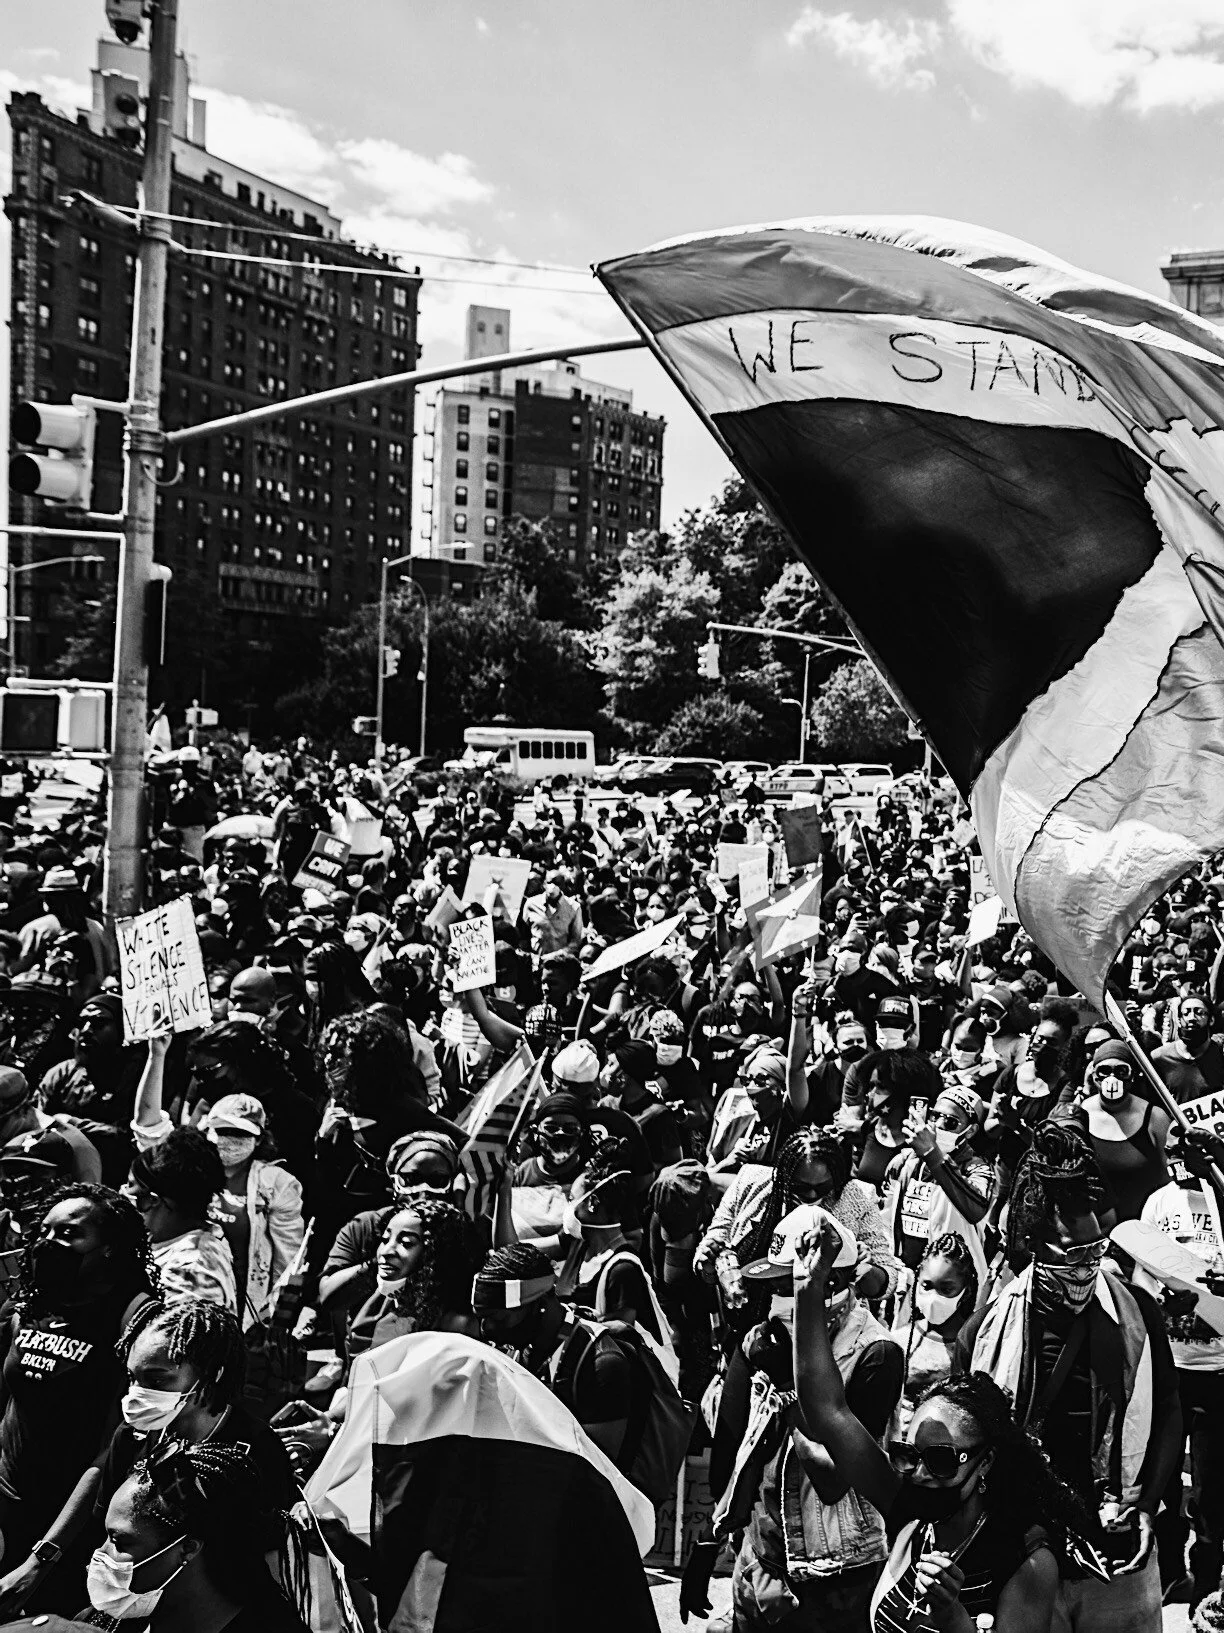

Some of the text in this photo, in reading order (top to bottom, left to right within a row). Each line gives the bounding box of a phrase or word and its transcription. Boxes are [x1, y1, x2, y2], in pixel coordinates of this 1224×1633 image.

[728, 319, 824, 384] WE
[122, 912, 170, 956] WHITE
[453, 920, 488, 938] BLACK
[126, 941, 186, 990] SILENCE
[124, 981, 208, 1036] VIOLENCE
[14, 1328, 94, 1363] FLATBUSH
[20, 1352, 57, 1372] BKLYN
